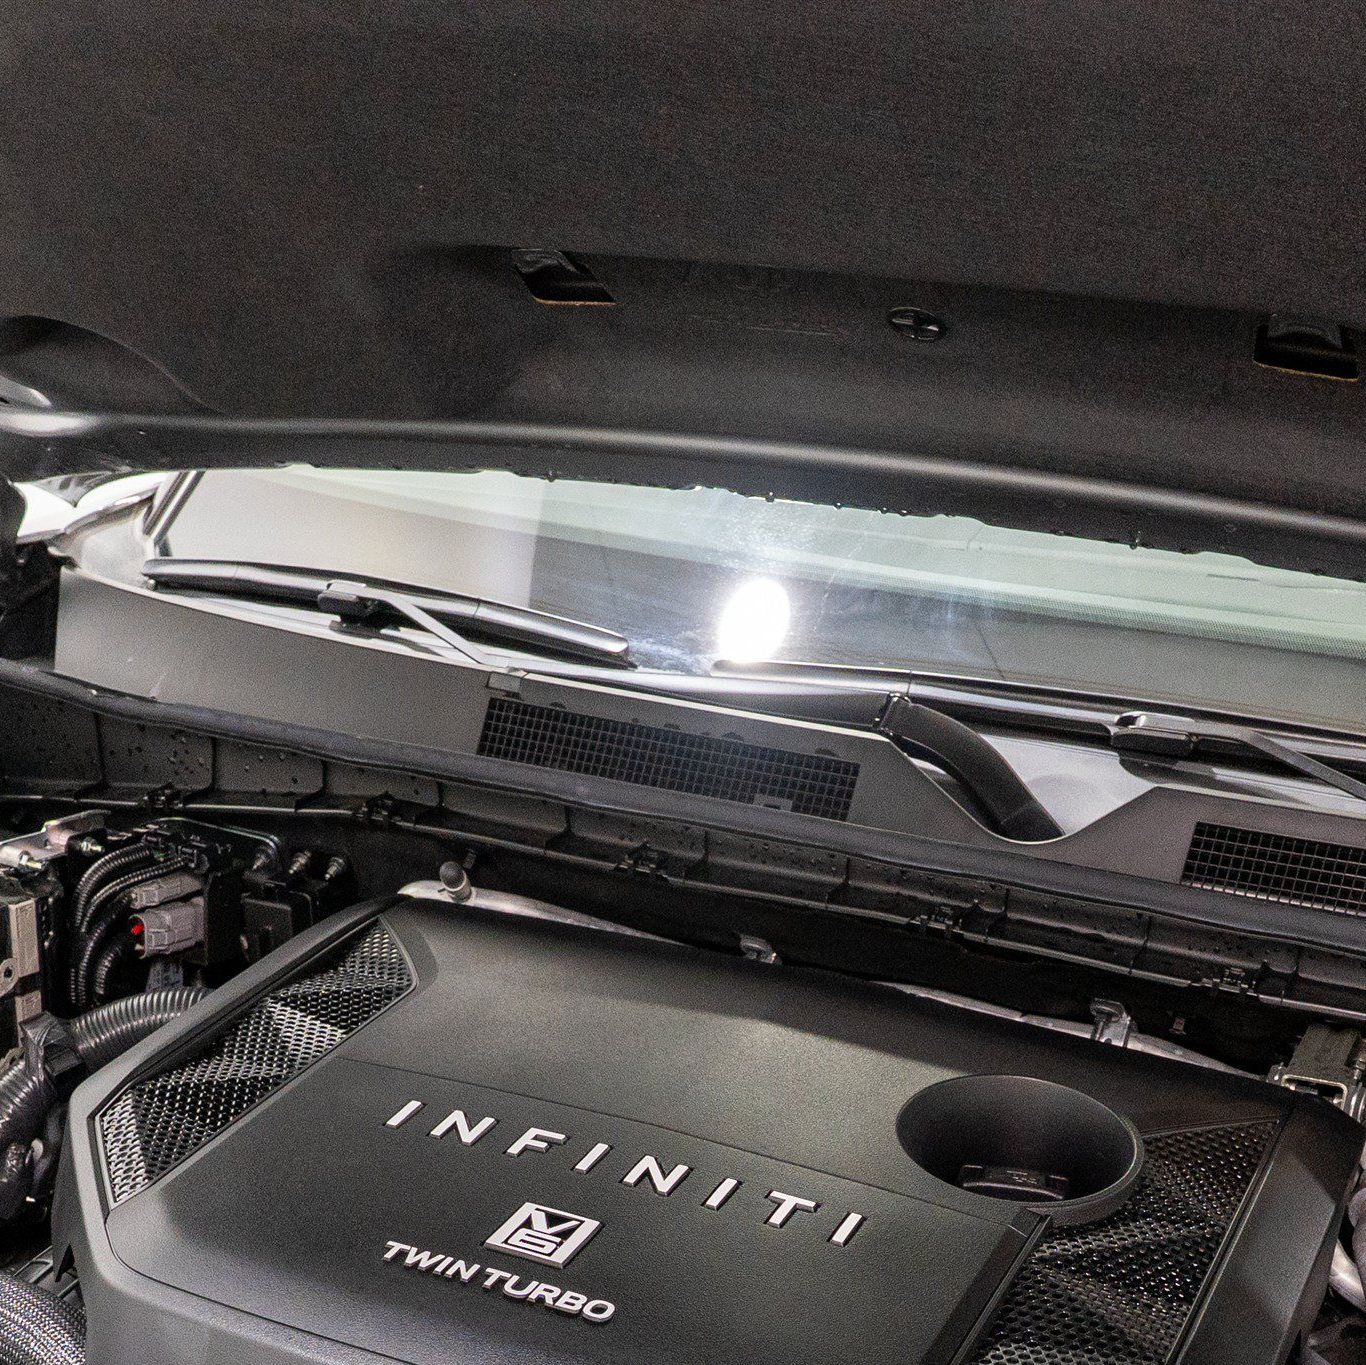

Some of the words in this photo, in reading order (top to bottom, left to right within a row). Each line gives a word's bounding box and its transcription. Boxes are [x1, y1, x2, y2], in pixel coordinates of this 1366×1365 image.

[384, 1099, 866, 1247] INFINITI
[382, 1239, 481, 1283] TWIN
[481, 1266, 617, 1325] TURBO
